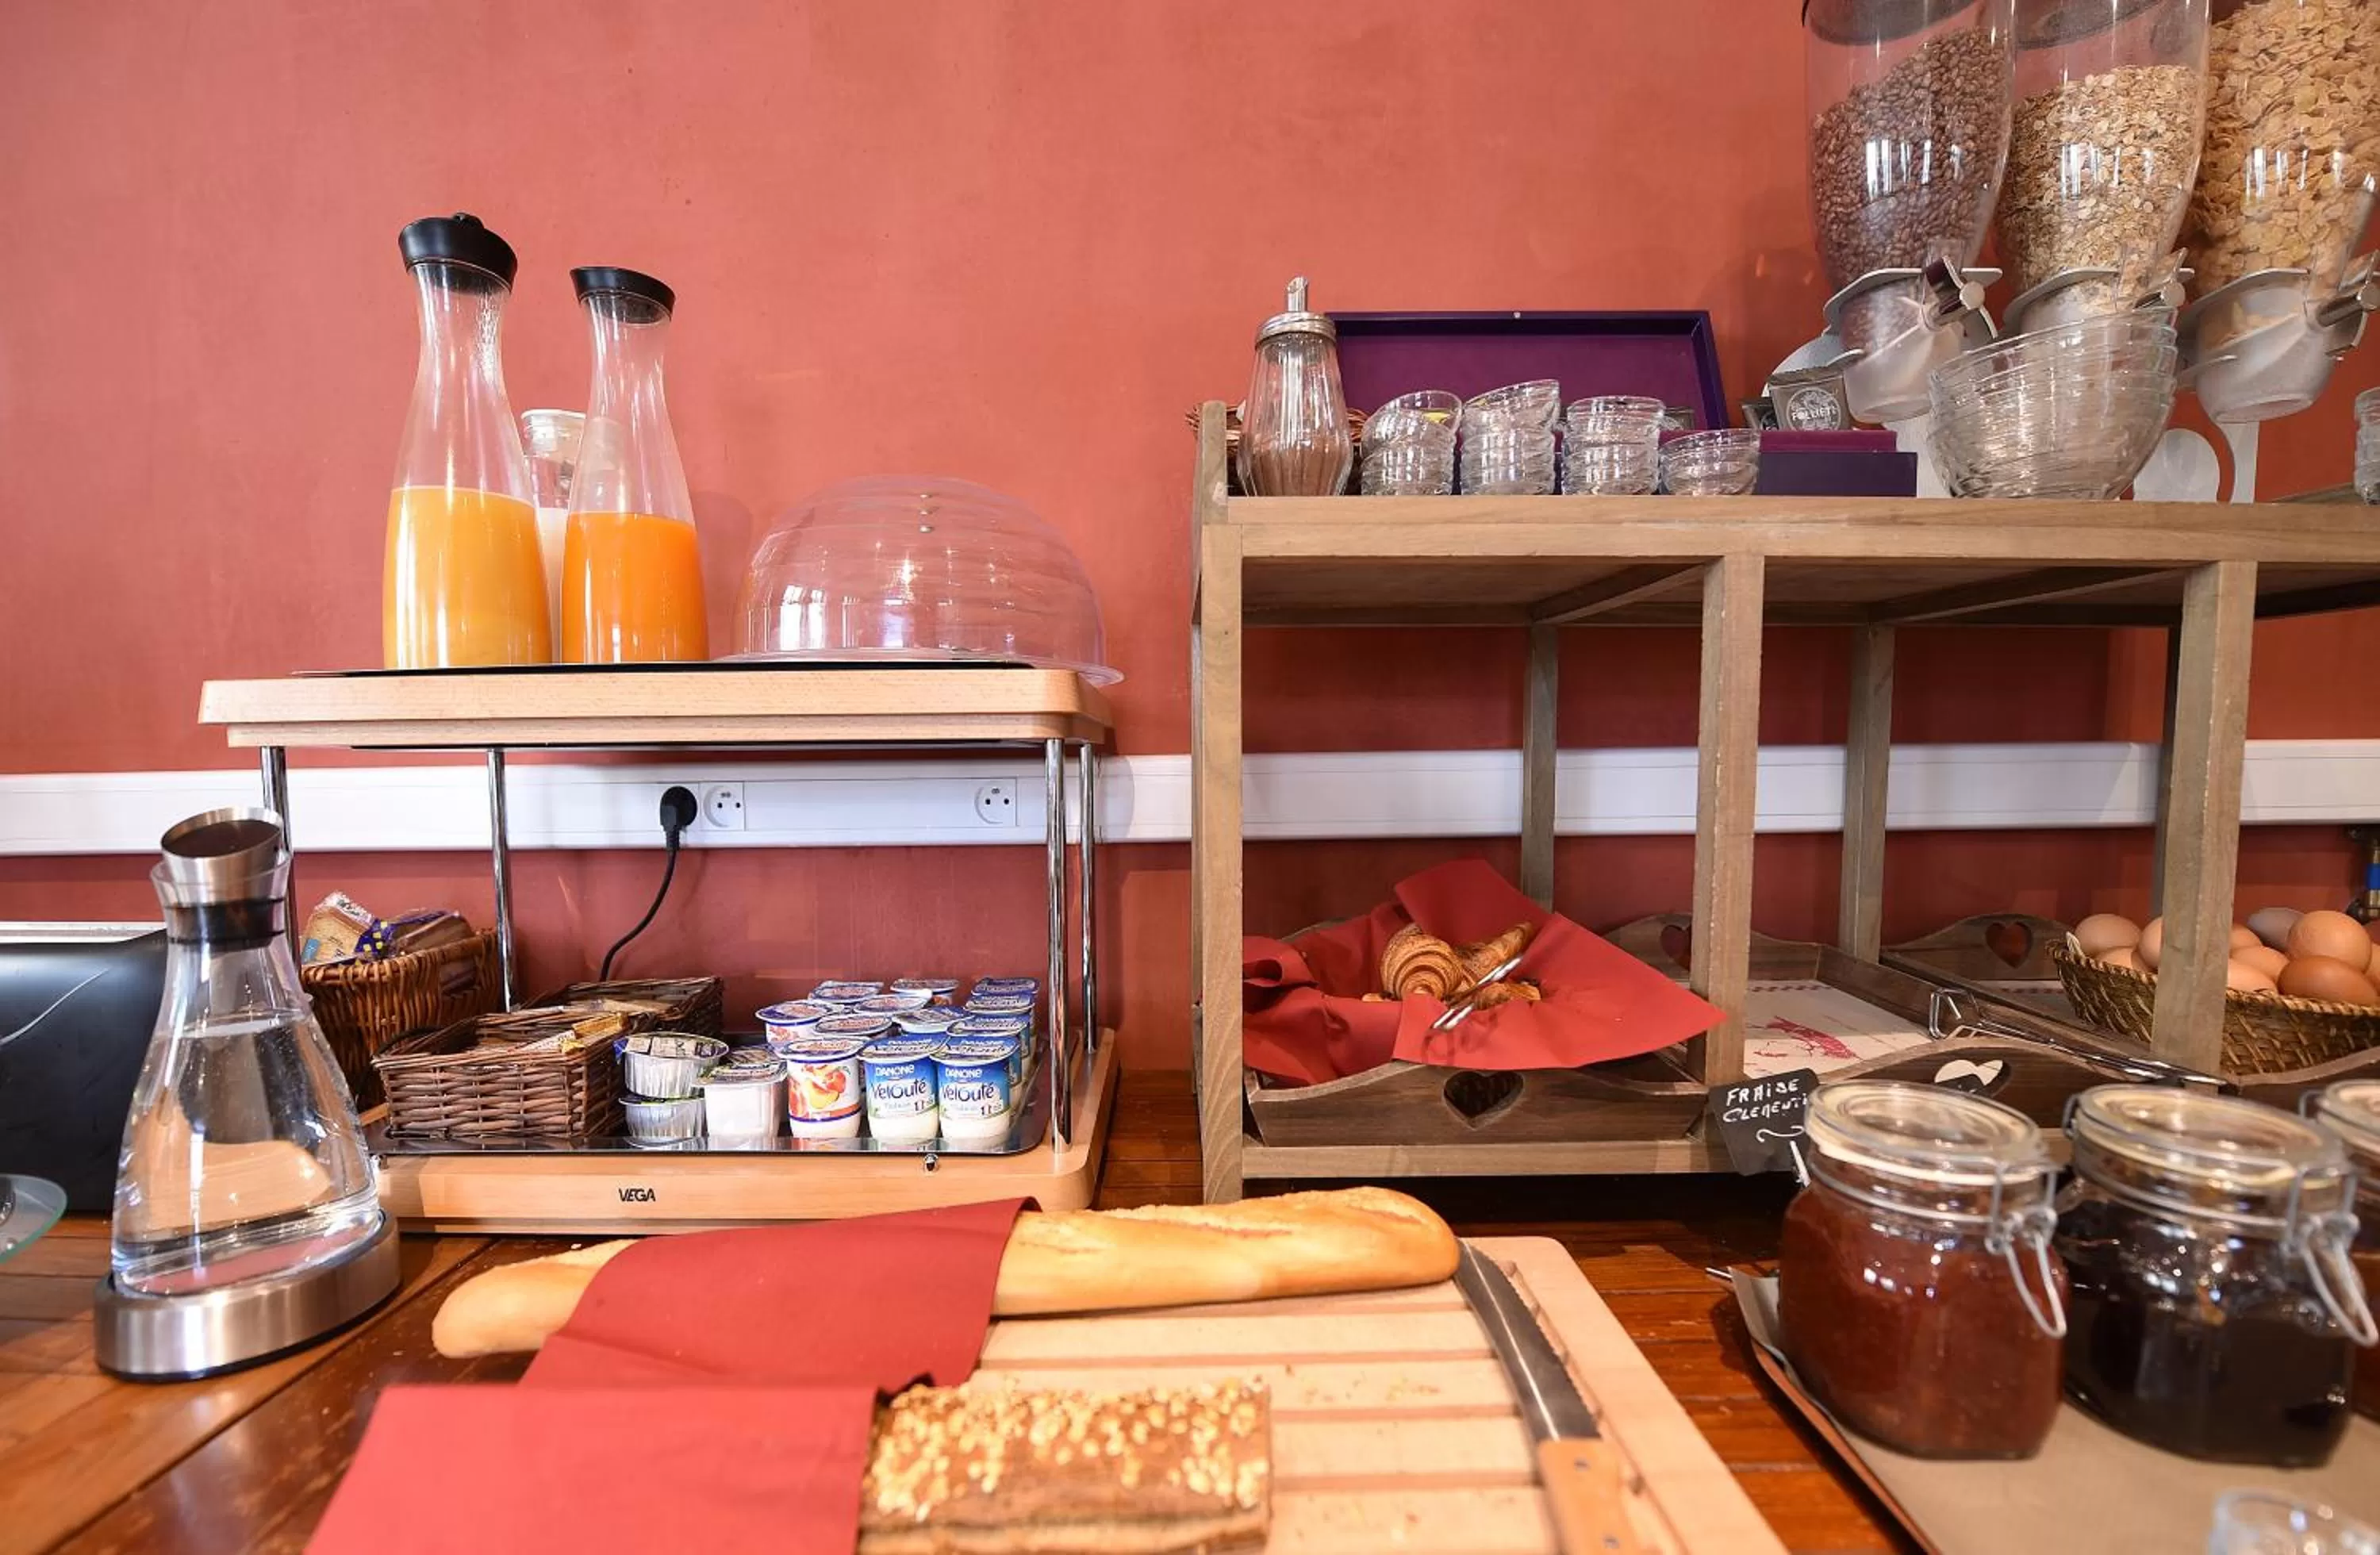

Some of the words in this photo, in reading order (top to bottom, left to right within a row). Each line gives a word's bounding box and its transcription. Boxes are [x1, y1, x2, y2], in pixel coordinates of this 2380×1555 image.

[875, 1064, 914, 1077] DANONE
[945, 1068, 982, 1078] DANONE
[873, 1077, 927, 1100] Velouté
[942, 1081, 994, 1102] Velouté
[619, 1188, 656, 1202] VEGA
